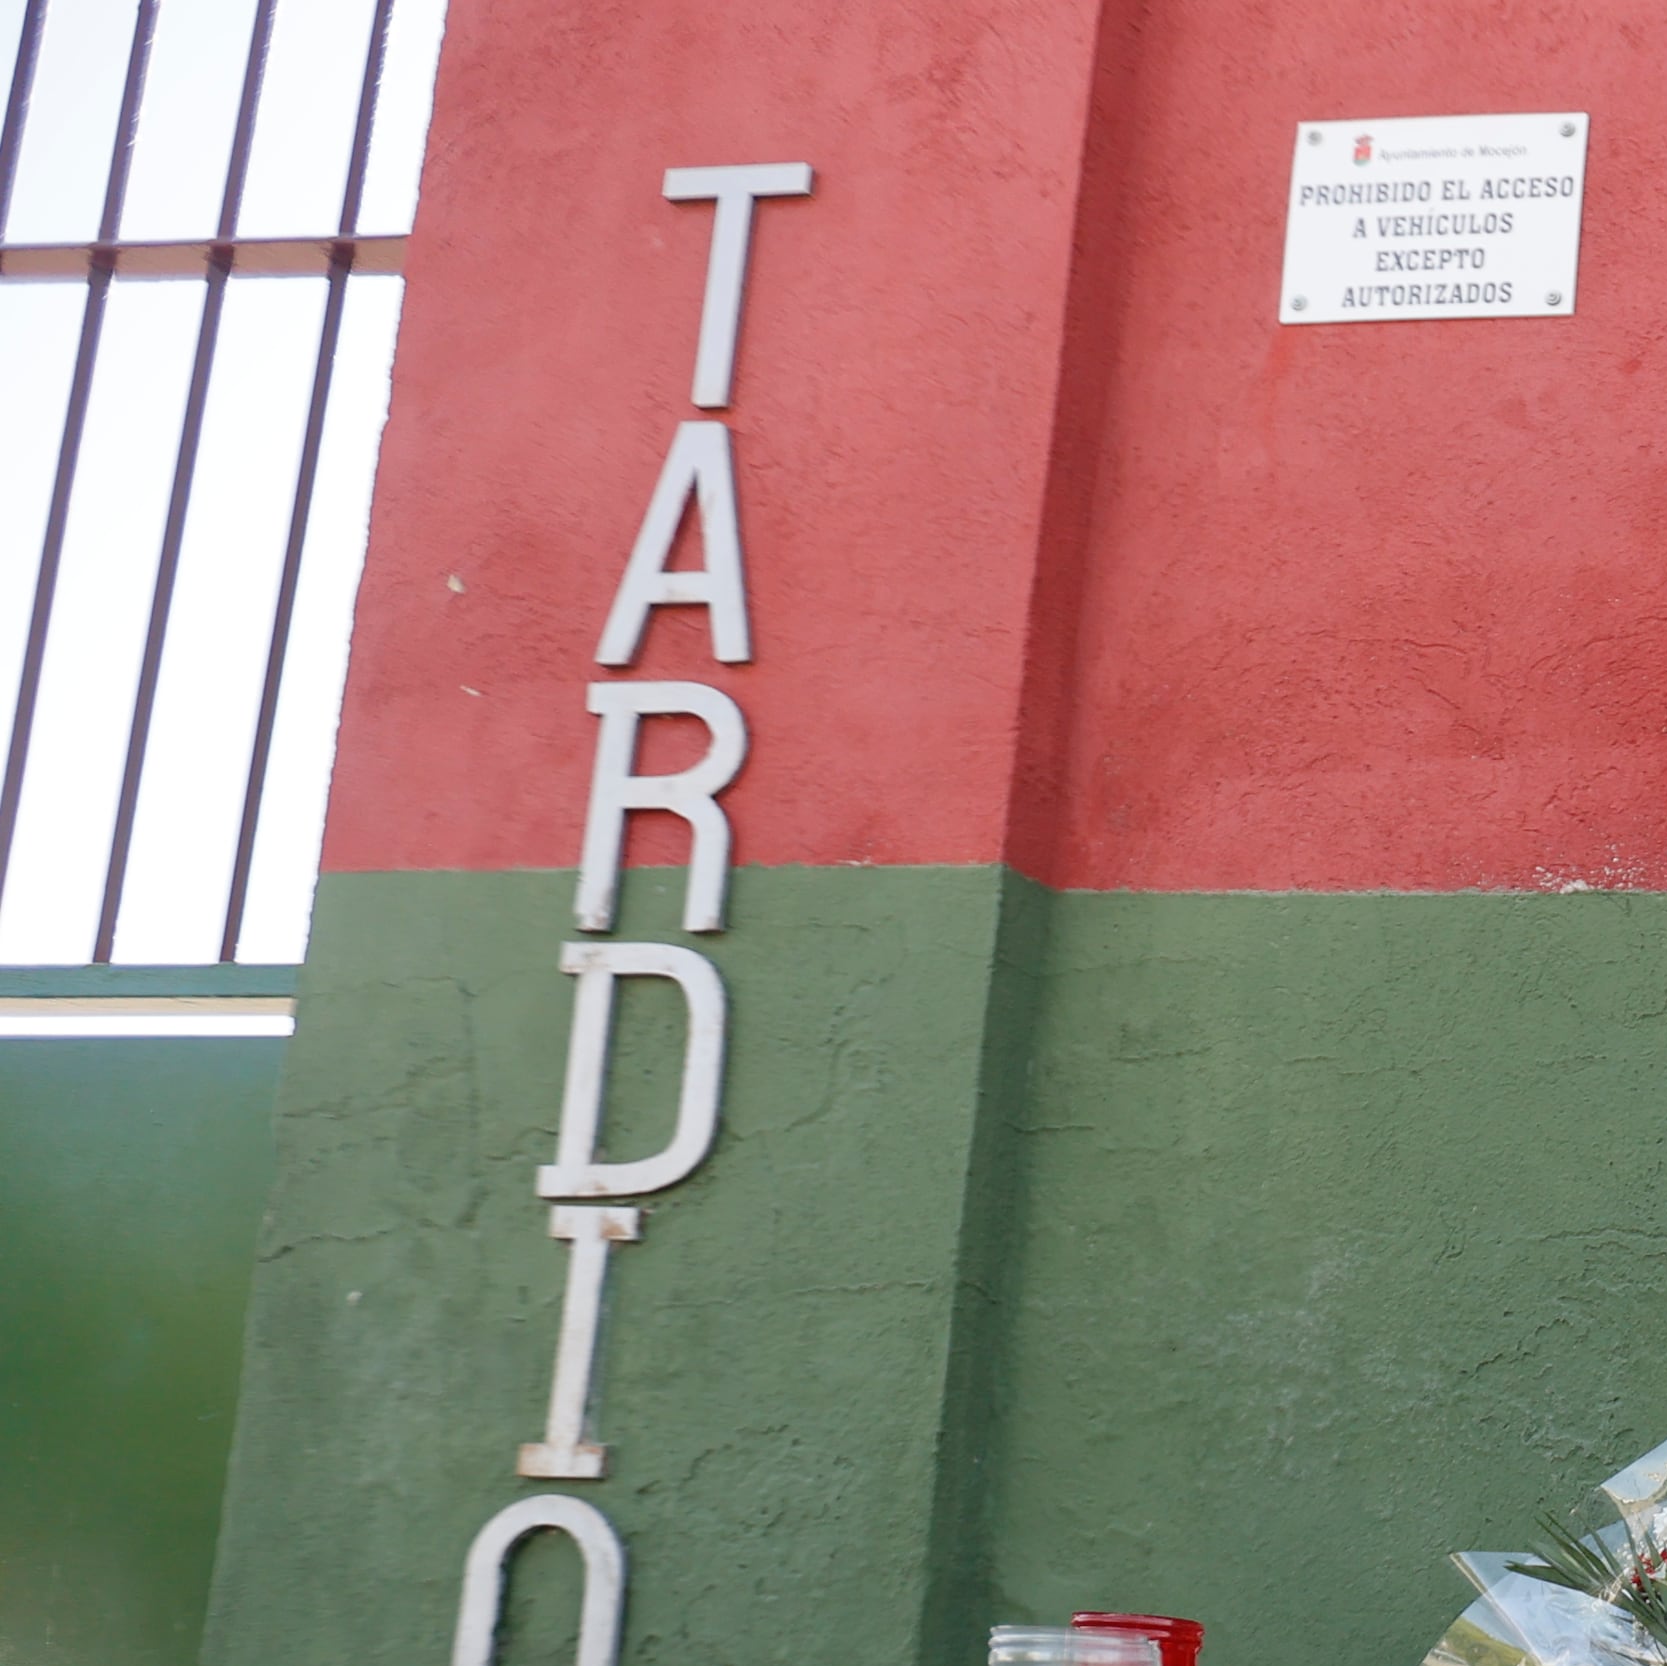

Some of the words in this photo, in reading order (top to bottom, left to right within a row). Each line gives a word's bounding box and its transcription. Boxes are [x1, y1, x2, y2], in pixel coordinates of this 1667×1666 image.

[1300, 181, 1432, 207] PROHIBIDO
[1442, 180, 1471, 201] EL
[1480, 176, 1575, 201] ACCESO
[1353, 218, 1367, 239] A
[1378, 208, 1514, 237] VEHÍCULOS
[1375, 248, 1485, 272] EXCEPTO
[1342, 282, 1513, 308] AUTORIZADOS
